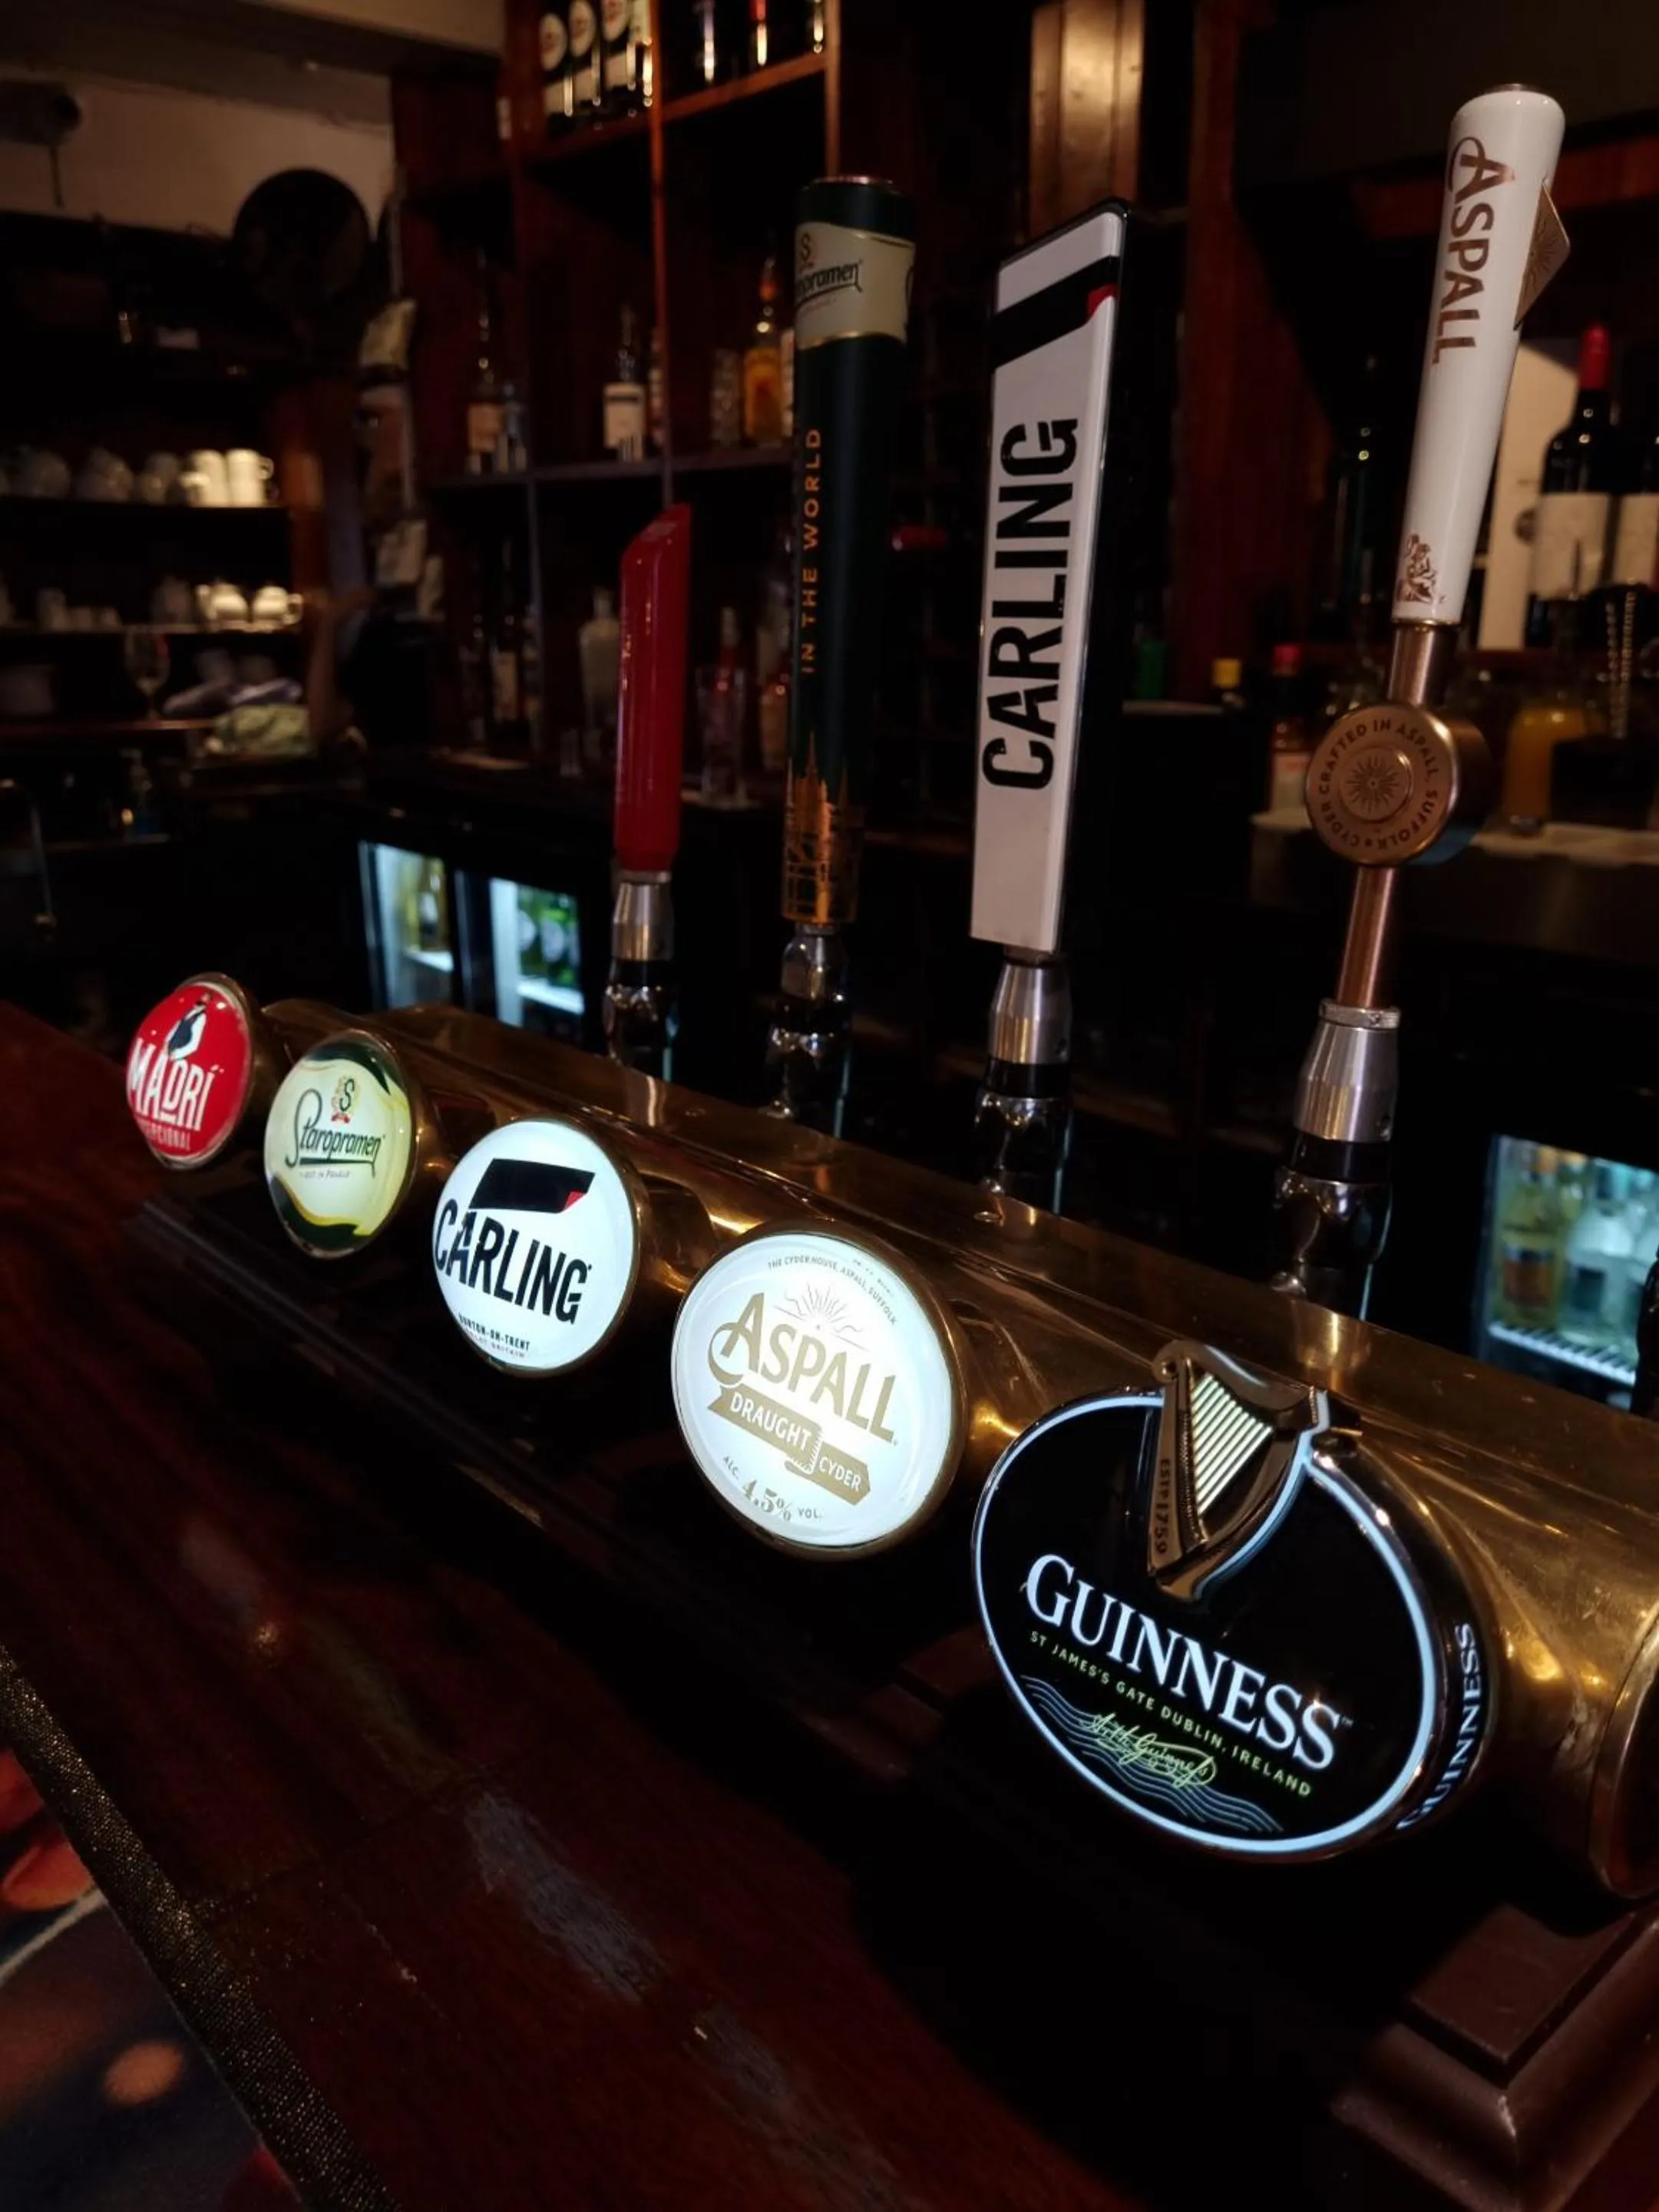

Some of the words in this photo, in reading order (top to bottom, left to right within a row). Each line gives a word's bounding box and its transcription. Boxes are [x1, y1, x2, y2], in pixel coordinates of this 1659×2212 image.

[1433, 137, 1516, 365] ASPALL
[803, 428, 821, 551] WORLD
[801, 567, 818, 628] THE
[982, 418, 1077, 789] CARLING
[801, 643, 816, 674] IN
[1319, 723, 1367, 795] CRAFTED
[1373, 719, 1391, 732] IN
[1320, 802, 1360, 847] CYDER
[1376, 789, 1438, 850] SUFFOLK
[285, 1089, 382, 1178] Staropramen
[435, 1199, 588, 1324] CARLING
[768, 1258, 782, 1270] THE
[868, 1287, 897, 1326] SUFFOLK
[708, 1292, 897, 1443] ASPALL
[730, 1391, 811, 1452] DRAUGHT
[819, 1456, 861, 1492] CYDER
[742, 1479, 791, 1521] 4.5%
[1154, 1503, 1168, 1554] 1759
[1025, 1554, 1341, 1769] GUINNESS
[1030, 1631, 1047, 1647] ST
[1052, 1644, 1110, 1685] JAMES'S
[1115, 1681, 1155, 1711] GATE
[1160, 1705, 1227, 1752] DUBLIN,
[1231, 1744, 1311, 1797] IRELAND
[1396, 1622, 1482, 1830] GUINNESS
